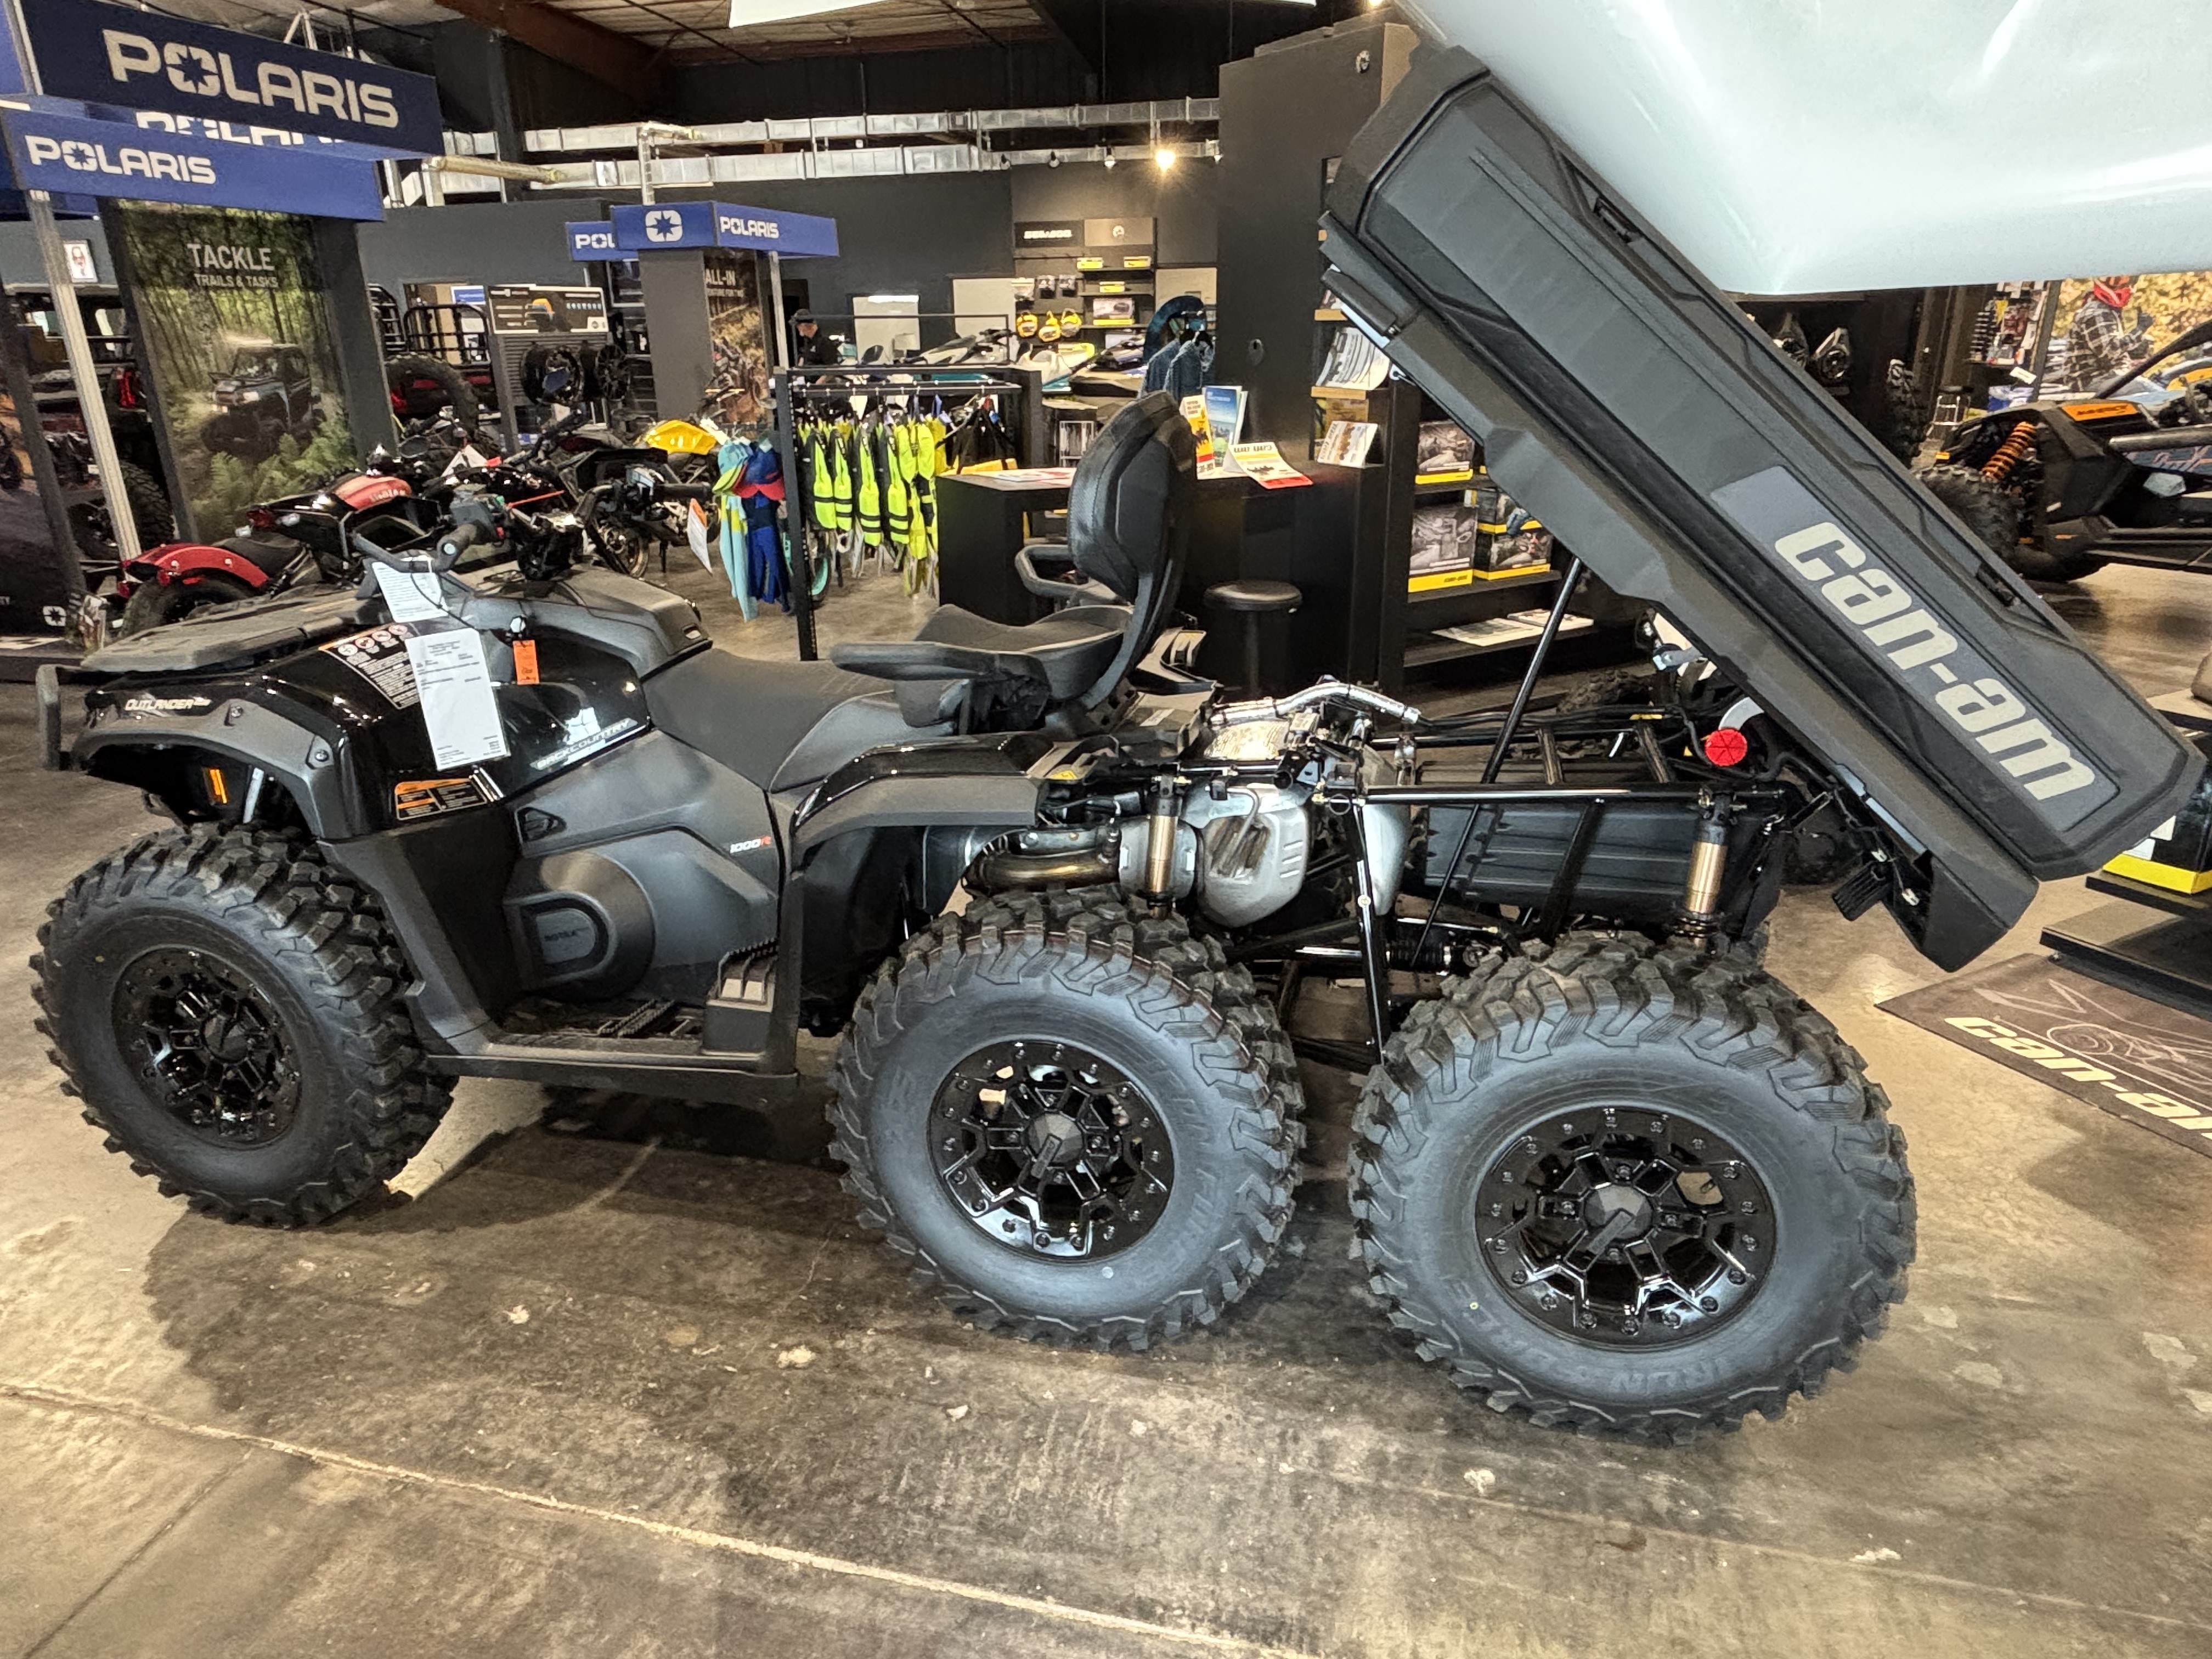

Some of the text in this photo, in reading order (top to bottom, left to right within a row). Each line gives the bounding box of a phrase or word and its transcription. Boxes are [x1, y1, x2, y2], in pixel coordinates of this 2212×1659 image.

[102, 29, 399, 129] POLARIS
[24, 135, 216, 184] POLARIS
[719, 216, 780, 239] POLARIS
[187, 244, 275, 271] TACKLE
[194, 273, 279, 290] TRAILS & TASKS
[1775, 521, 2096, 801] can-am
[125, 699, 194, 711] OUTLANDER
[535, 718, 631, 769] BACKCOUNTRY
[730, 836, 771, 853] 1000R
